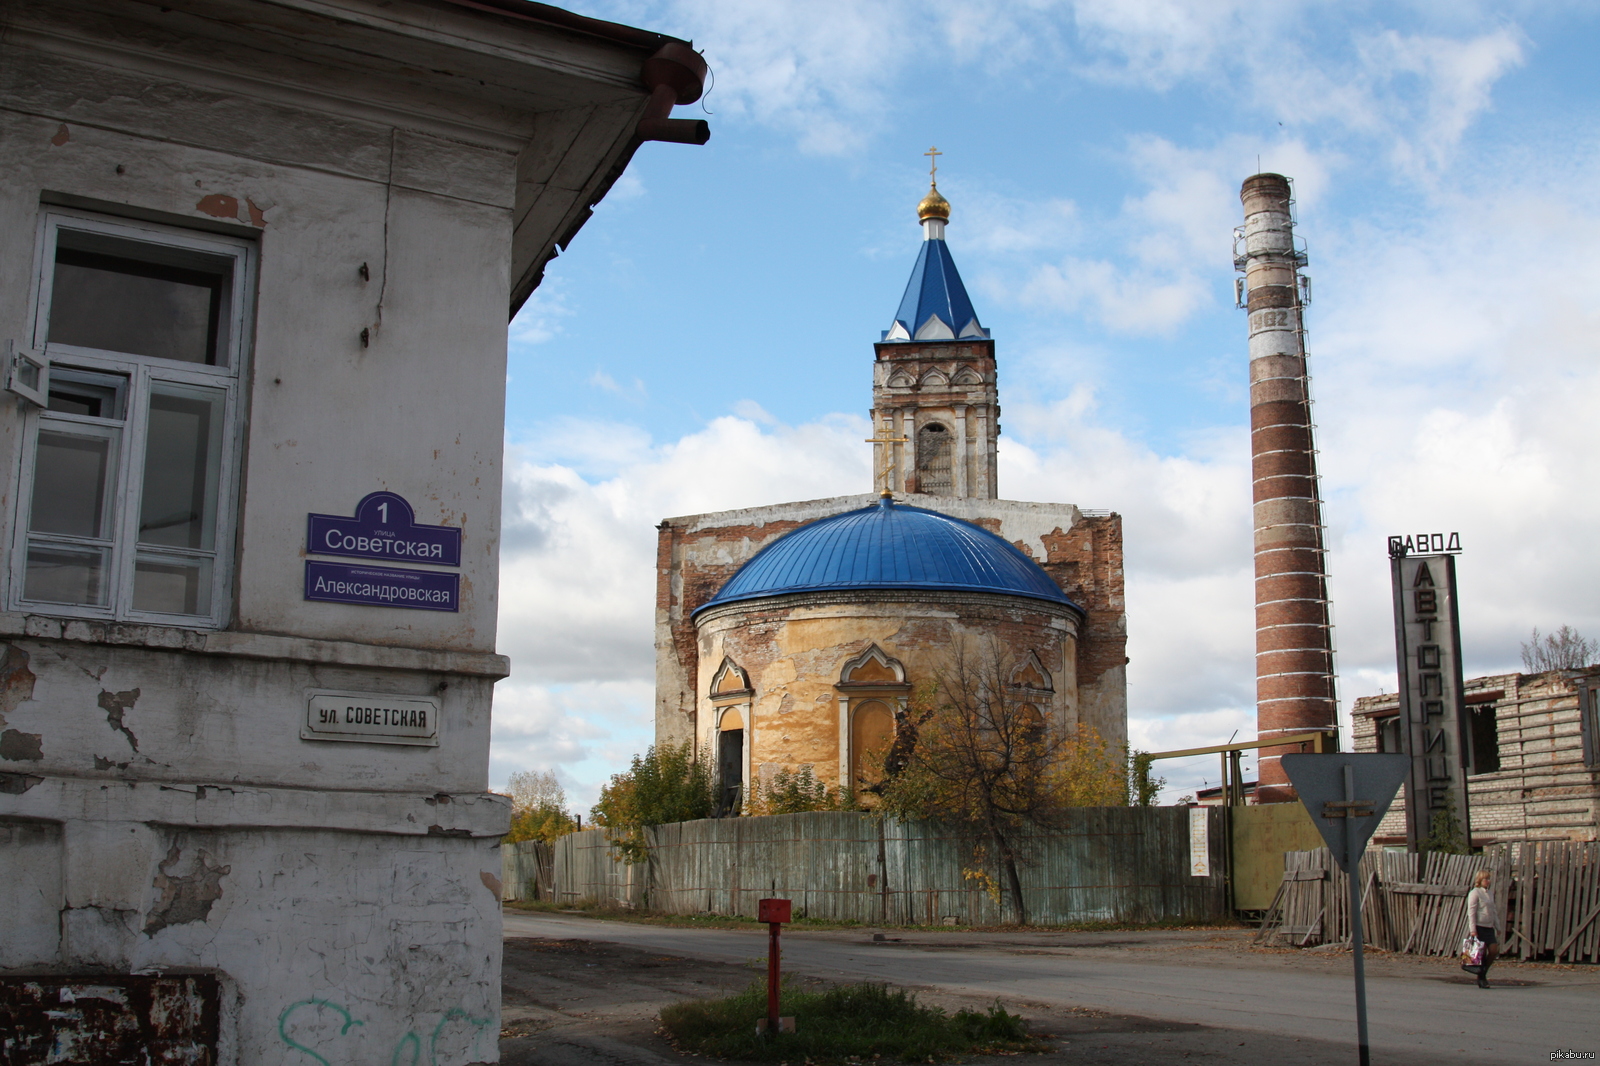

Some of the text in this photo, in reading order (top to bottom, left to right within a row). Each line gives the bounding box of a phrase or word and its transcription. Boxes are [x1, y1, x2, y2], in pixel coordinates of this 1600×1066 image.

[377, 502, 388, 524] 1
[325, 529, 443, 558] Советская
[315, 575, 450, 603] Александровская
[346, 706, 427, 728] СОВЕТСКАЯ
